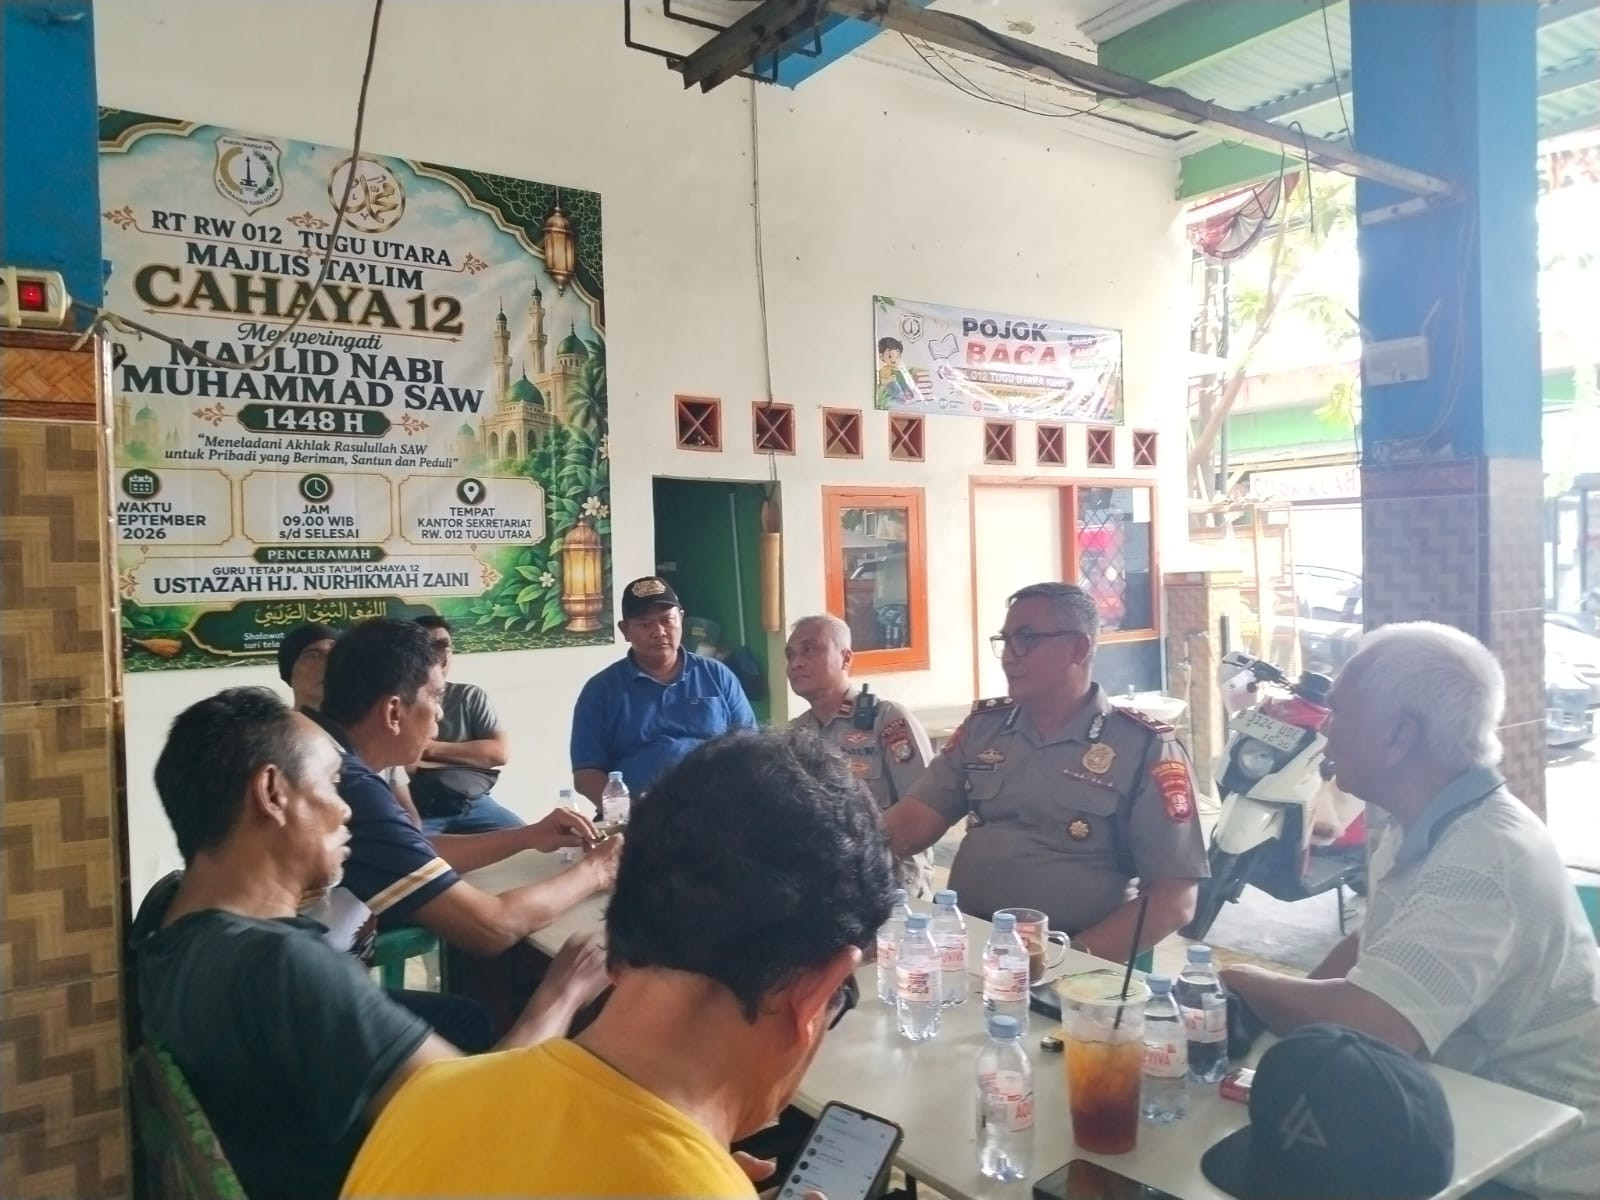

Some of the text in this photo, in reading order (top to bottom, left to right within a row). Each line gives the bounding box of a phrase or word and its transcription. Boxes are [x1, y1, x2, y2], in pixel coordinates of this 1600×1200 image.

[151, 210, 453, 267] RT RW 012 TUGU UTARA
[186, 241, 310, 278] MAJLIS
[133, 264, 464, 335] CAHAYA 12
[962, 316, 1048, 342] POJOK
[965, 341, 1057, 365] BACA
[170, 338, 444, 385] MAULID NABI
[121, 364, 484, 414] MUHAMMAD SAW
[264, 408, 365, 433] 1448 H
[285, 438, 330, 452] Akhlak
[334, 441, 397, 454] Rasulullah
[400, 443, 428, 455] SAW
[165, 448, 204, 460] untuk
[208, 448, 257, 462] Pribadi
[259, 453, 290, 466] yang
[293, 452, 348, 466] Beriman,
[350, 454, 392, 467] Santun
[395, 455, 417, 467] dan
[117, 502, 172, 514] WAKTU
[302, 505, 330, 515] JAM
[449, 507, 496, 517] TEMPAT
[117, 515, 206, 527] EPTEMBER
[282, 516, 355, 527] 09.00 WIB
[417, 518, 532, 529] KANTOR SEKRETARIAT
[122, 528, 167, 540] 2026
[279, 528, 359, 539] s/d SELESAI
[421, 529, 532, 540] RW. 012 TUGU UTARA
[267, 549, 371, 560] PENCERAMAH
[212, 566, 246, 576] GURU
[249, 566, 284, 575] TETAP
[286, 565, 326, 575] MAJLIS
[365, 564, 407, 573] CAHAYA
[409, 564, 420, 572] 12
[153, 573, 469, 594] USTAZAH HJ. NURHIKMAH ZAINI
[243, 632, 285, 641] Shalawat
[243, 641, 280, 649] suri tela
